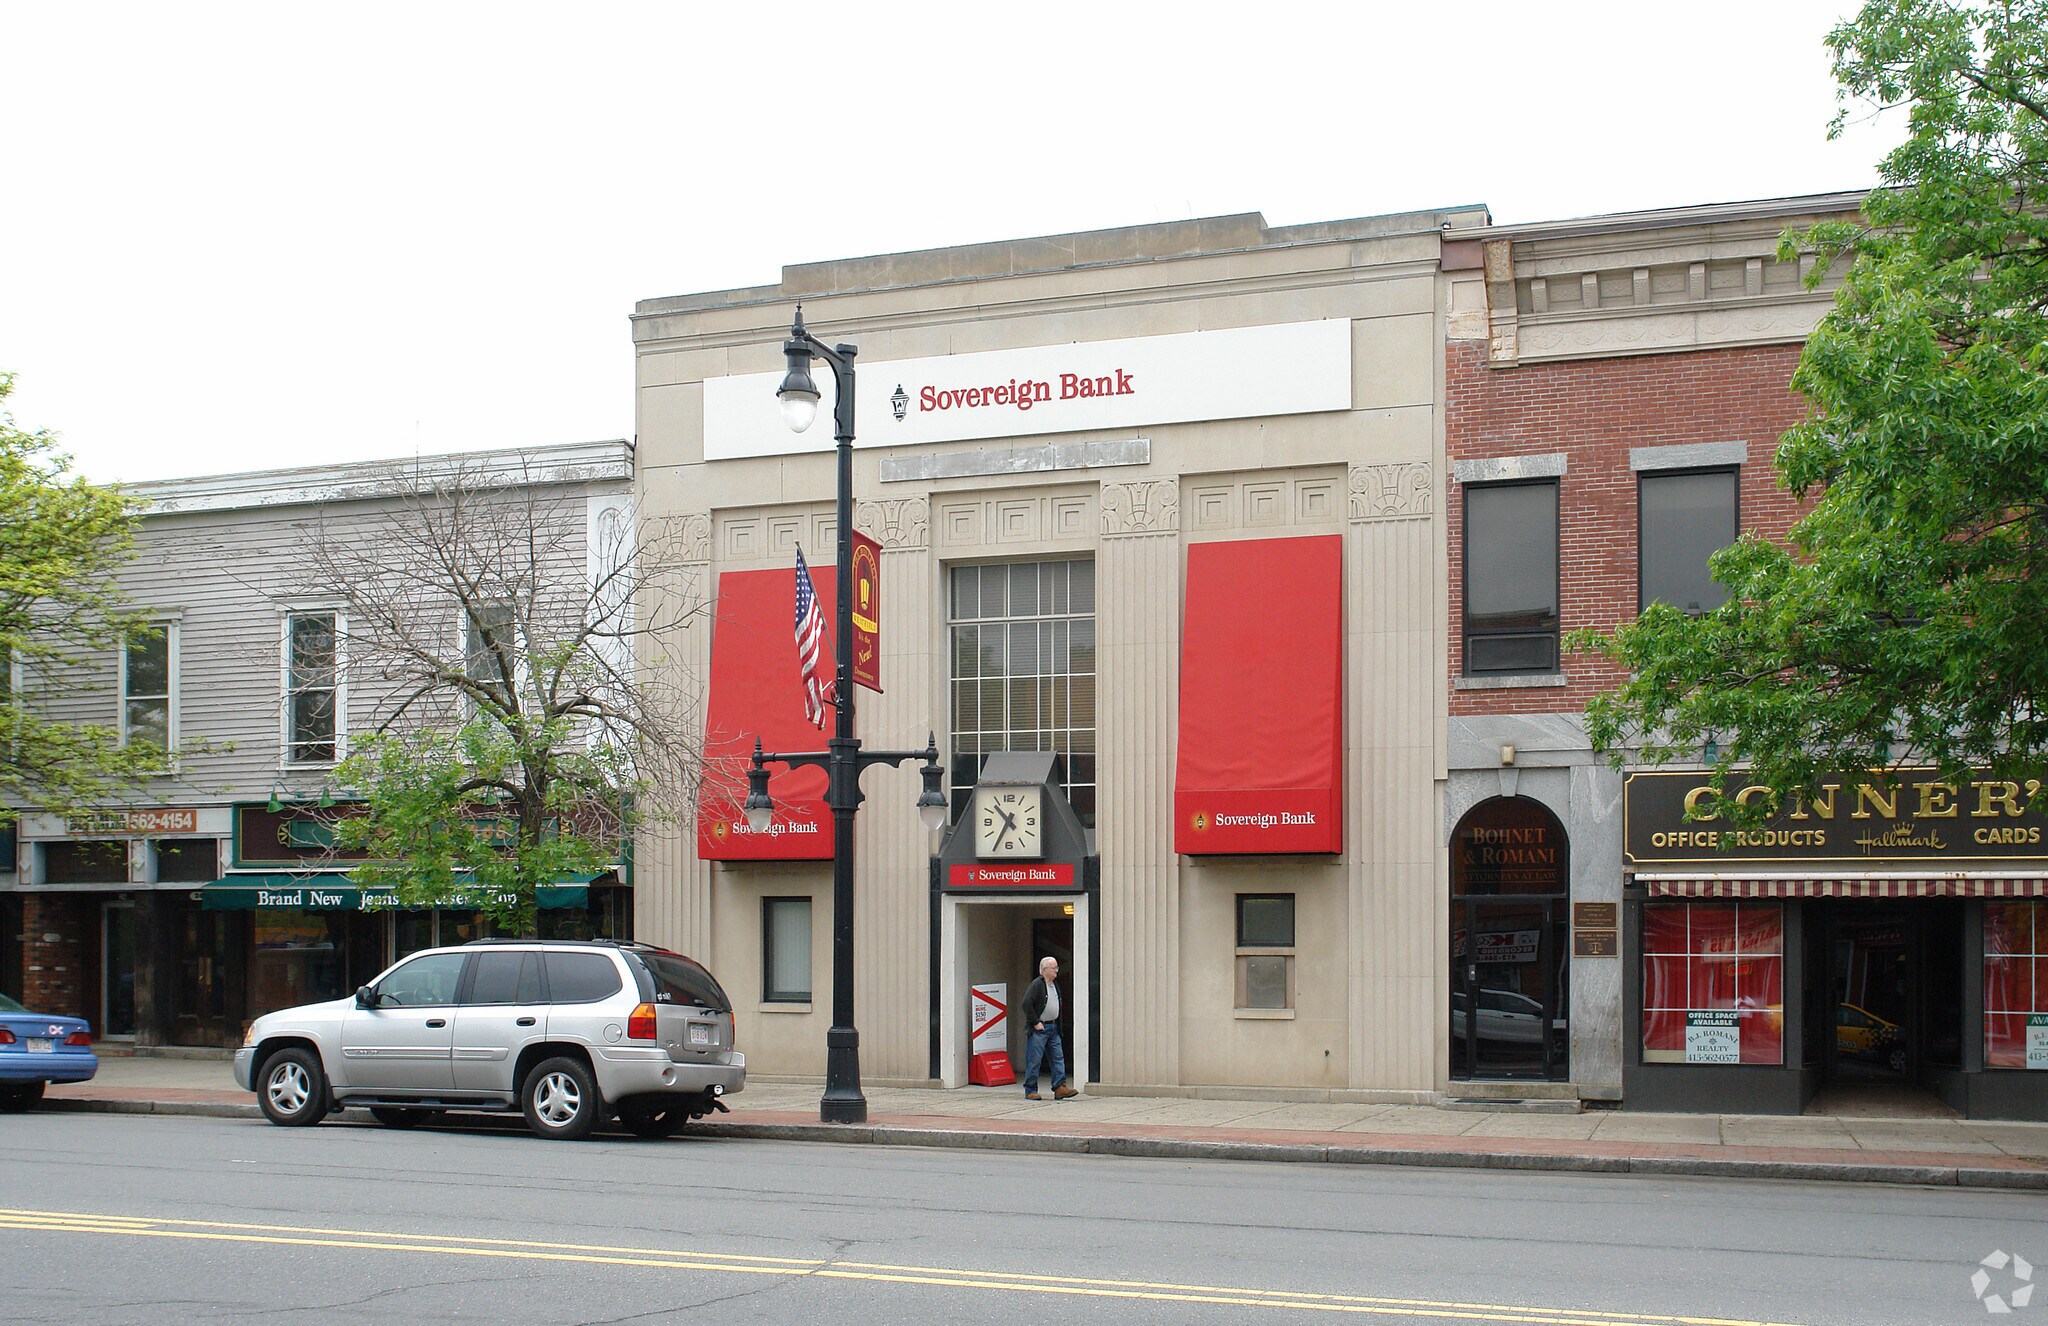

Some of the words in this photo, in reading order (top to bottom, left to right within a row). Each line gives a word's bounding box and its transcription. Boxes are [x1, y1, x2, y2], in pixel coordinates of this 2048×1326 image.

[919, 378, 1052, 411] Sovereign
[1059, 368, 1135, 400] Bank
[1003, 794, 1016, 803] 12
[130, 812, 193, 830] 562-4154
[788, 820, 818, 834] Bank
[984, 818, 993, 827] 9
[1026, 817, 1036, 826] 3
[1215, 812, 1278, 829] Sovereign
[1280, 811, 1316, 826] Bank
[1473, 826, 1546, 845] BOHNET
[1651, 831, 1718, 848] OFFICE
[1853, 828, 1948, 857] Hallmark
[1973, 826, 2041, 845] CARDS
[1004, 841, 1014, 850] 6
[1463, 849, 1476, 865] &
[1482, 846, 1556, 865] ROMANI
[978, 869, 1027, 883] Sovereign
[1029, 868, 1056, 881] Bank
[1535, 870, 1556, 881] LAW
[257, 890, 302, 907] Brand
[309, 890, 343, 907] New
[1702, 1030, 1739, 1044] ROMANI
